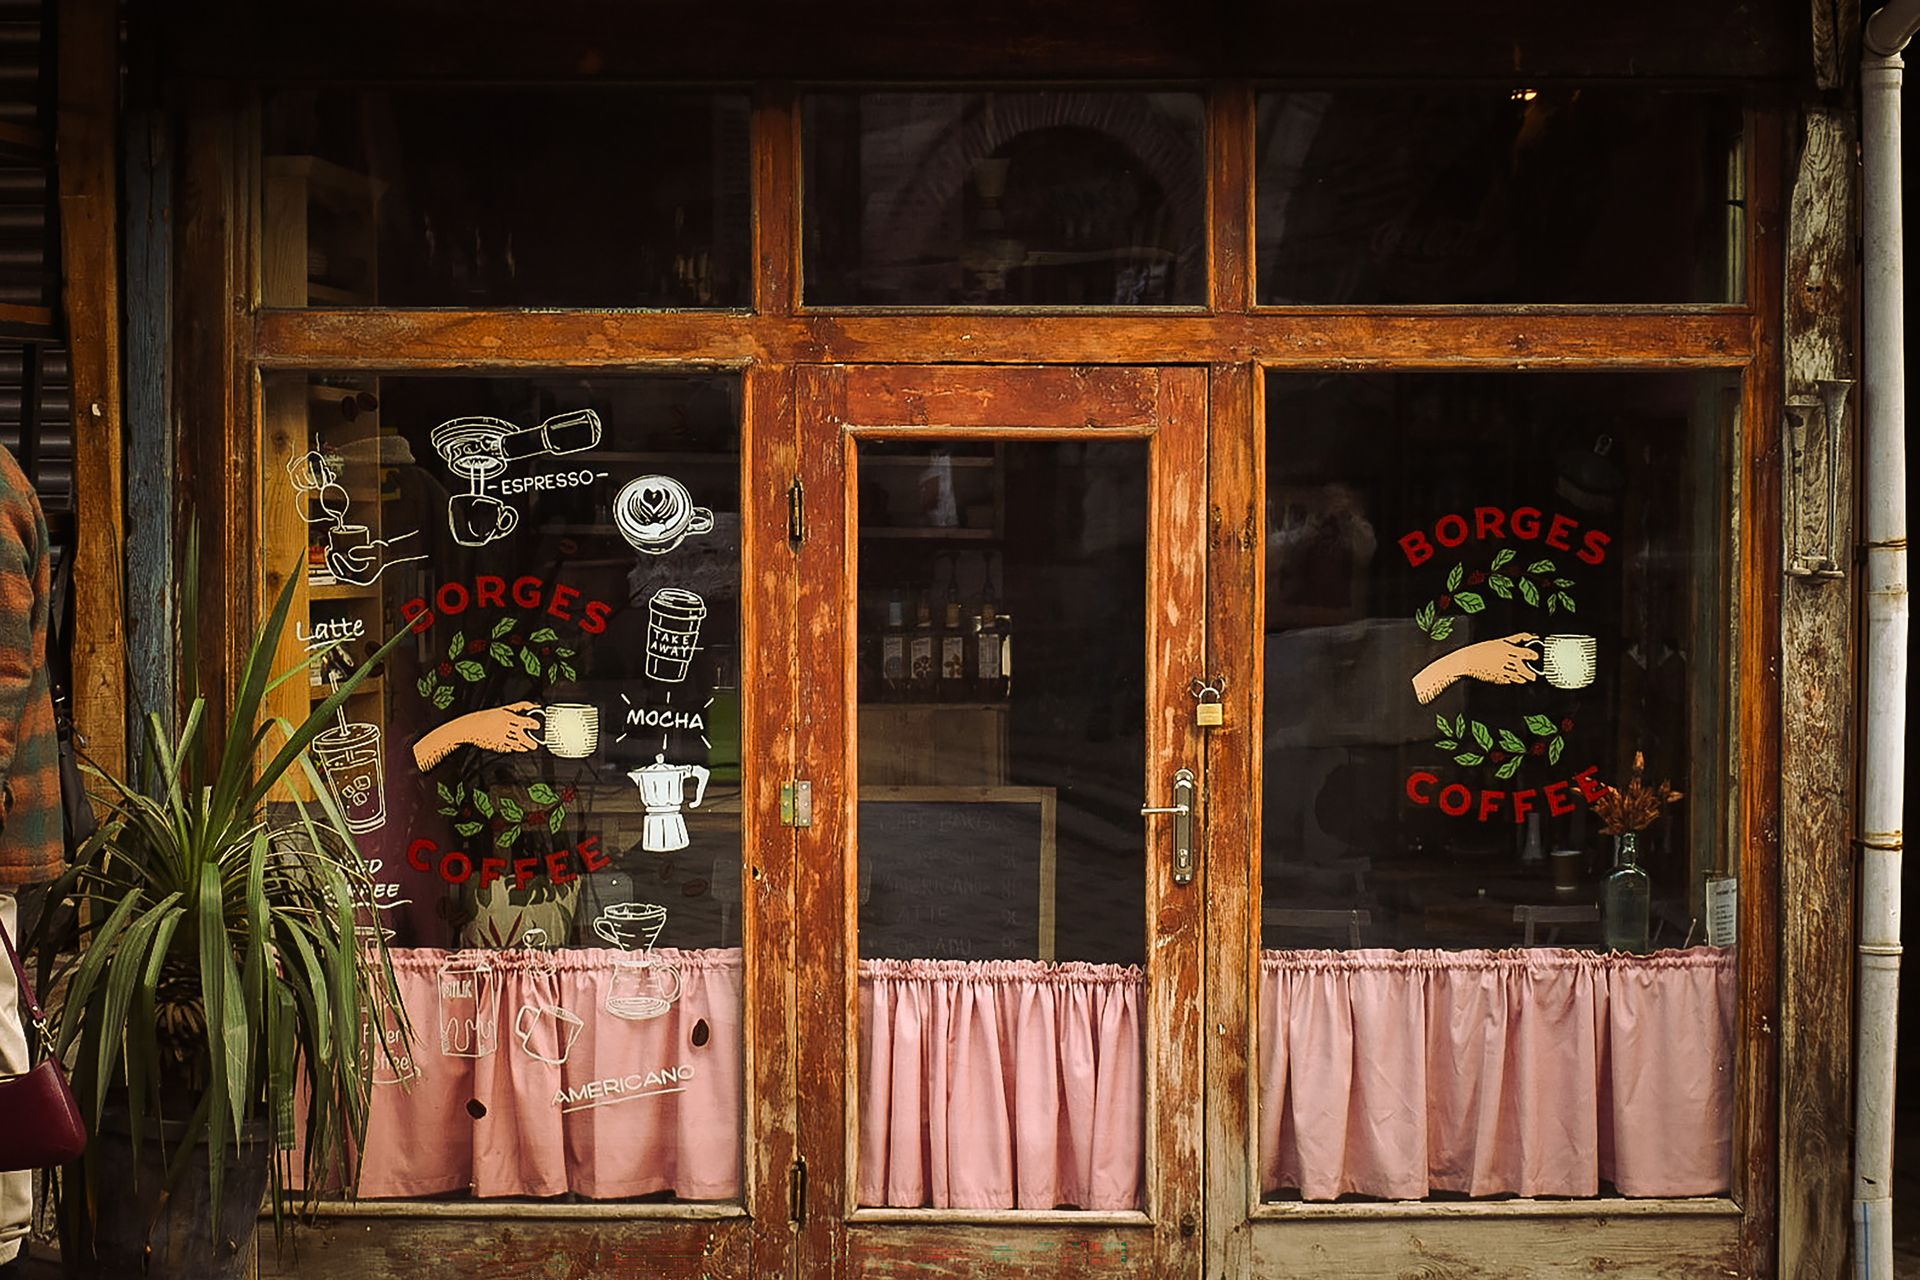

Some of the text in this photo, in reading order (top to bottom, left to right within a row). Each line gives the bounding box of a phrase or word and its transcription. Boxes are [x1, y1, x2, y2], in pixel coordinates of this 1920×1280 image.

[1397, 505, 1612, 568] BORGES
[400, 575, 613, 635] BORGES
[296, 617, 365, 641] Latte
[653, 628, 691, 645] TAKE
[650, 642, 690, 658] AWAY
[626, 708, 704, 731] MOCHA
[1405, 765, 1610, 825] COFFEE
[406, 835, 612, 891] COFFEE
[441, 979, 473, 999] MILK
[551, 1064, 695, 1106] AMERICANO
